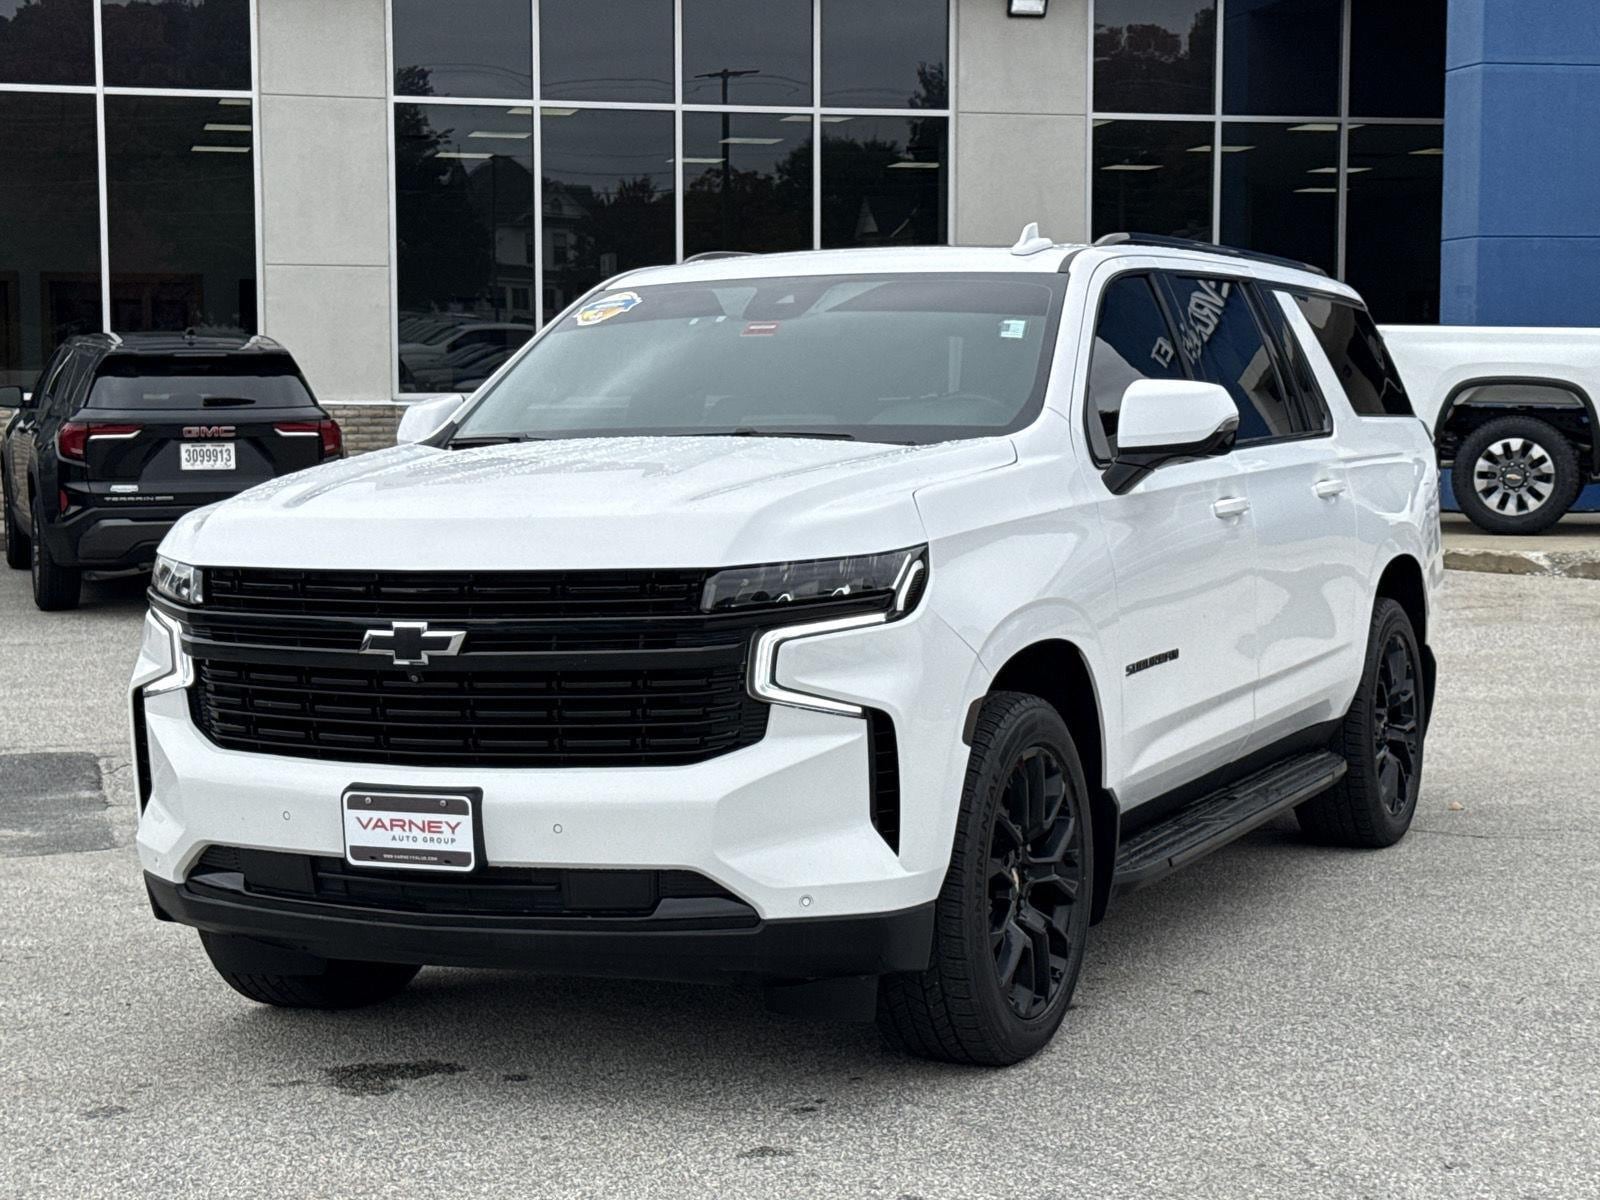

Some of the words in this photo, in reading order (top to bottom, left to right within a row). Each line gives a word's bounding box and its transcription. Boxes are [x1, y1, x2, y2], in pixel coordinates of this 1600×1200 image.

[183, 426, 236, 437] GMC
[185, 449, 231, 462] 3099913
[1125, 648, 1179, 677] SUBURBAN
[356, 817, 461, 834] VARNEY
[391, 835, 418, 843] AUTO
[422, 836, 457, 845] GROUP
